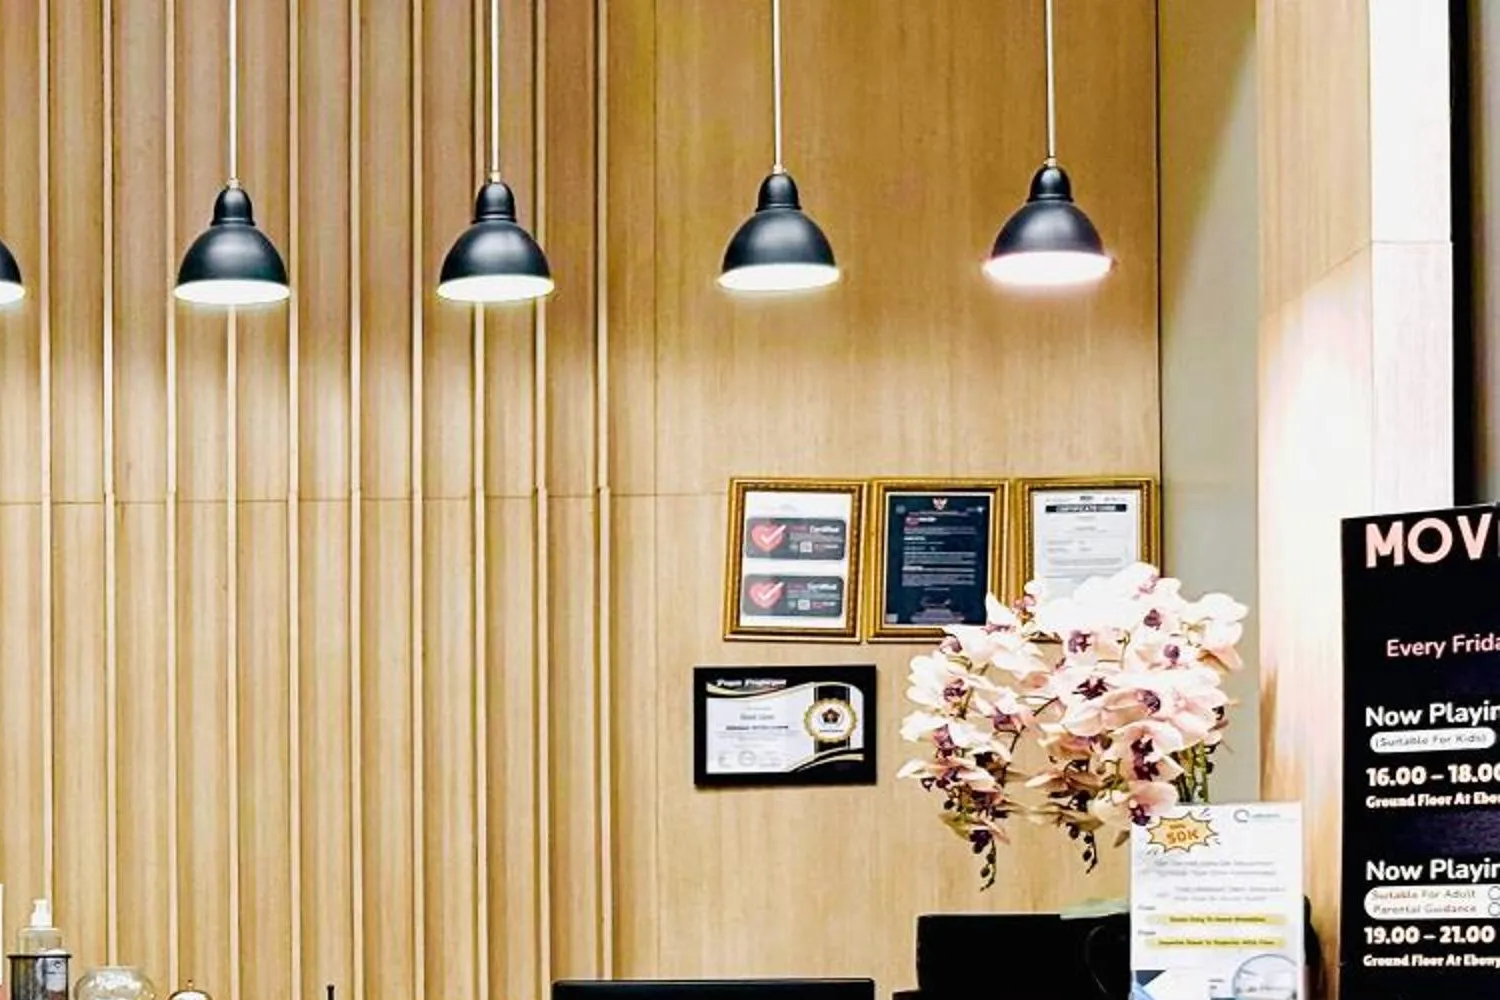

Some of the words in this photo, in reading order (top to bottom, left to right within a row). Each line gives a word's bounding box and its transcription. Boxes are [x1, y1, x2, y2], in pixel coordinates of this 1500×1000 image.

[1366, 513, 1500, 568] MOV
[1387, 639, 1447, 660] Every
[1366, 705, 1422, 727] Now
[1429, 700, 1500, 726] Playin
[1366, 766, 1427, 787] 16.00
[1365, 793, 1415, 808] Ground
[1417, 793, 1452, 807] Floor
[1454, 791, 1471, 805] At
[1166, 830, 1200, 844] 50K
[1366, 860, 1423, 881] Now
[1430, 857, 1500, 883] Playin
[1373, 904, 1420, 914] Parental
[1364, 926, 1420, 944] 19.00
[1439, 925, 1496, 944] 21.00
[1363, 953, 1409, 967] Ground
[1411, 953, 1444, 967] Floor
[1445, 953, 1462, 967] At
